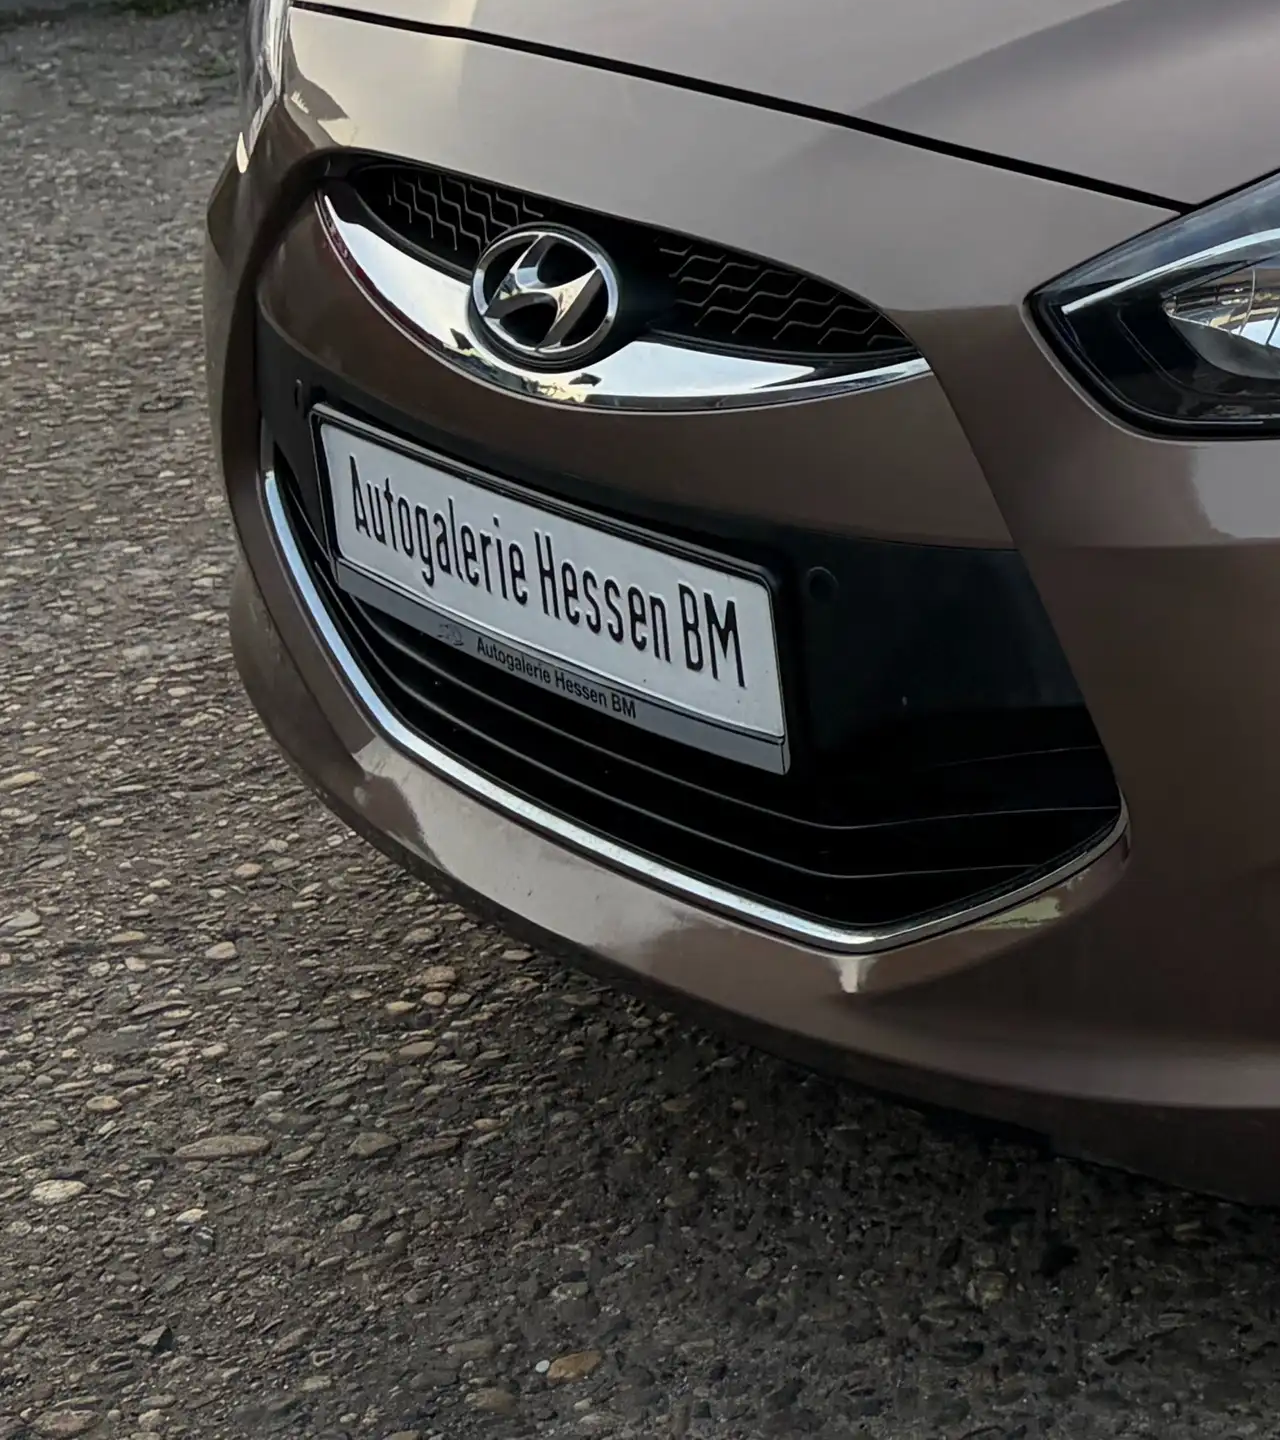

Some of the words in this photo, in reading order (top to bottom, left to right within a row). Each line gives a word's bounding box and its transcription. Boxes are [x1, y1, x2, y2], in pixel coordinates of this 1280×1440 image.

[349, 454, 528, 606] Autogalerie
[535, 530, 671, 662] Hessen
[678, 582, 746, 688] BM
[476, 636, 551, 685] Autogalerie
[555, 670, 607, 708] Hessen
[611, 694, 636, 719] BM
